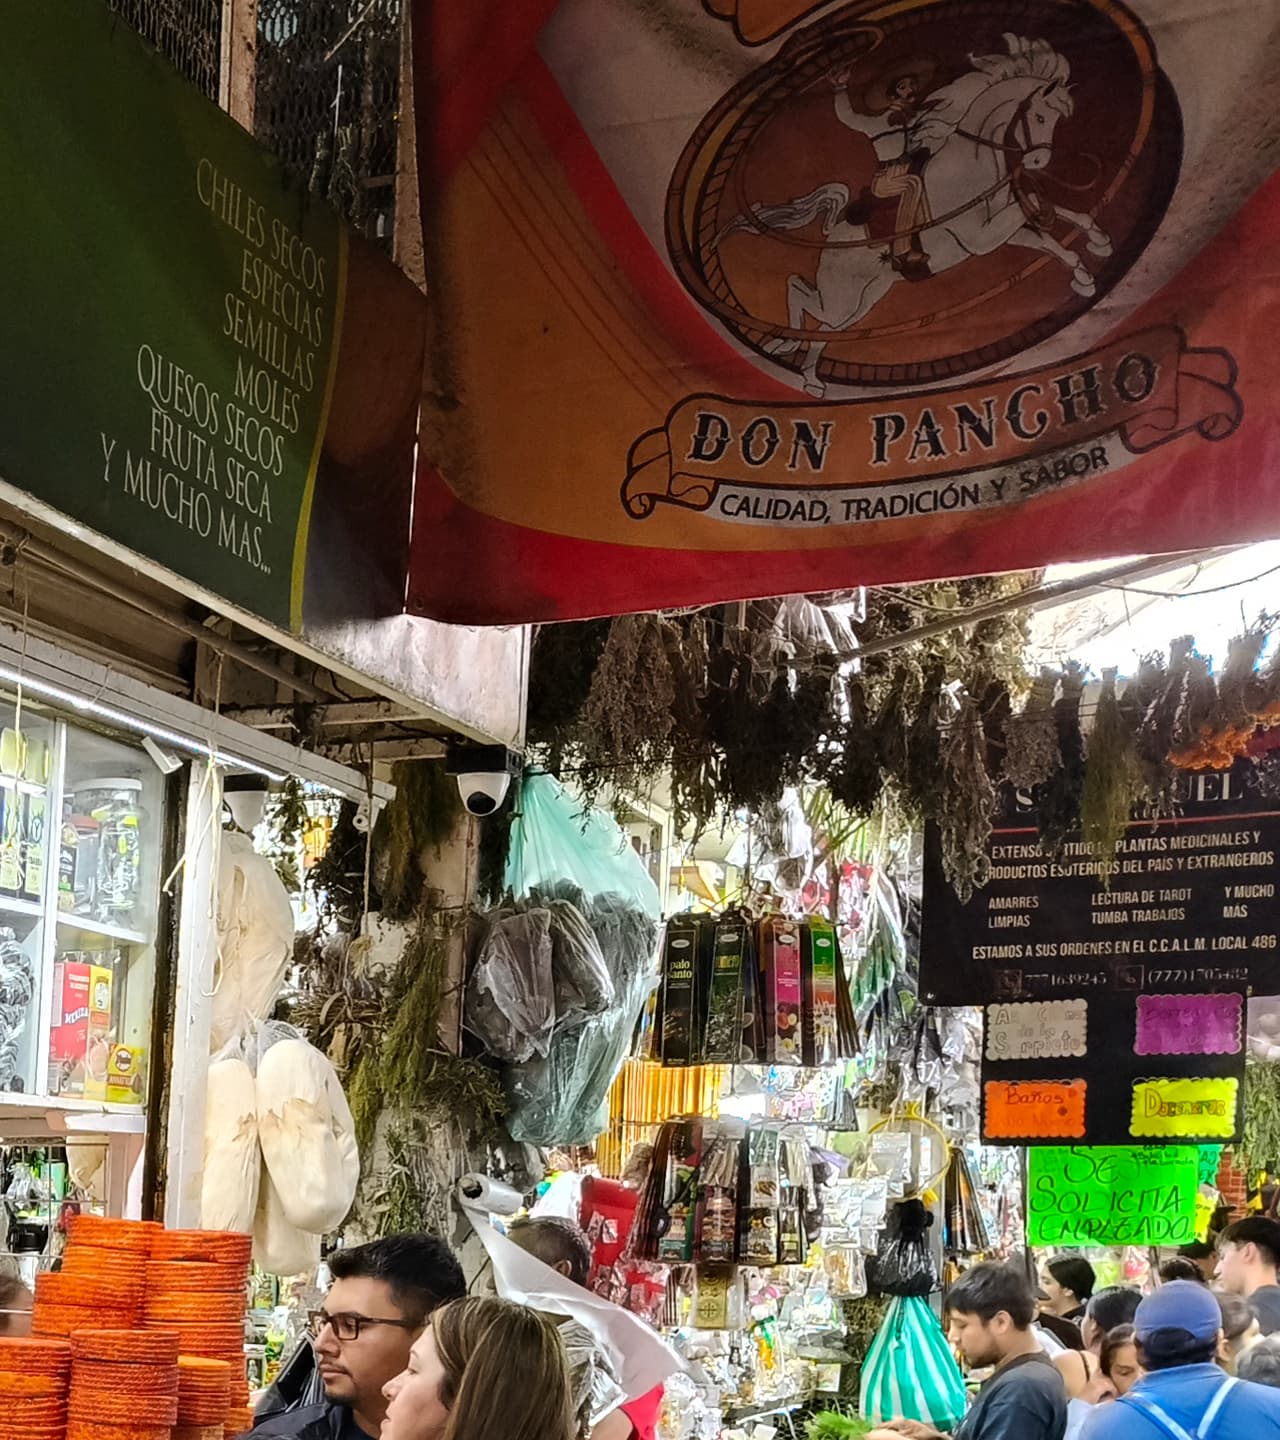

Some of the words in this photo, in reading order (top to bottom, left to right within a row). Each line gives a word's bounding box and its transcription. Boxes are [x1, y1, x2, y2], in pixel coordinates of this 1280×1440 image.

[196, 158, 265, 248] CHILES
[271, 218, 325, 298] SECOS
[241, 249, 322, 348] ESPECIAS
[223, 293, 314, 392] SEMILLAS
[137, 344, 220, 435] QUESOS
[225, 403, 284, 476] SECOS
[234, 354, 300, 434] MOLES
[686, 409, 834, 473] DON
[868, 350, 1159, 468] PANCHO
[100, 431, 117, 483] Y
[123, 449, 212, 537] MUCHO
[150, 407, 219, 491] FRUTA
[225, 457, 273, 524] SECA
[719, 492, 831, 525] CALIDAD,
[842, 480, 981, 522] TRADICIÓN
[990, 476, 1008, 498] Y
[1019, 445, 1111, 493] SABOR
[988, 863, 1048, 880] RODUCTOS
[1122, 859, 1145, 874] DEL
[1175, 856, 1185, 871] Y
[1187, 851, 1275, 870] EXTRANGEROS
[1115, 836, 1168, 853] PLANTAS
[1169, 831, 1250, 850] MEDICINALES
[1252, 831, 1262, 844] Y
[988, 895, 1040, 911] AMARRES
[1091, 890, 1140, 907] LECTURA
[1141, 889, 1155, 904] DE
[1159, 887, 1193, 903] TAROT
[1224, 885, 1233, 899] Y
[1234, 884, 1275, 900] MUCHO
[988, 914, 1032, 929] LIMPIAS
[1091, 910, 1129, 926] TUMBA
[1131, 907, 1186, 923] TRABAJOS
[972, 944, 1024, 961] ESTAMOS
[1025, 943, 1034, 958] A
[1035, 942, 1058, 958] SUS
[1060, 940, 1113, 957] ORDENES
[1115, 939, 1131, 954] EN
[1133, 939, 1148, 954] EL
[1211, 934, 1249, 950] LOCAL
[1251, 934, 1278, 949] 486
[1029, 1175, 1184, 1215] SOLICITA
[1039, 1215, 1190, 1242] EMPLEADO
